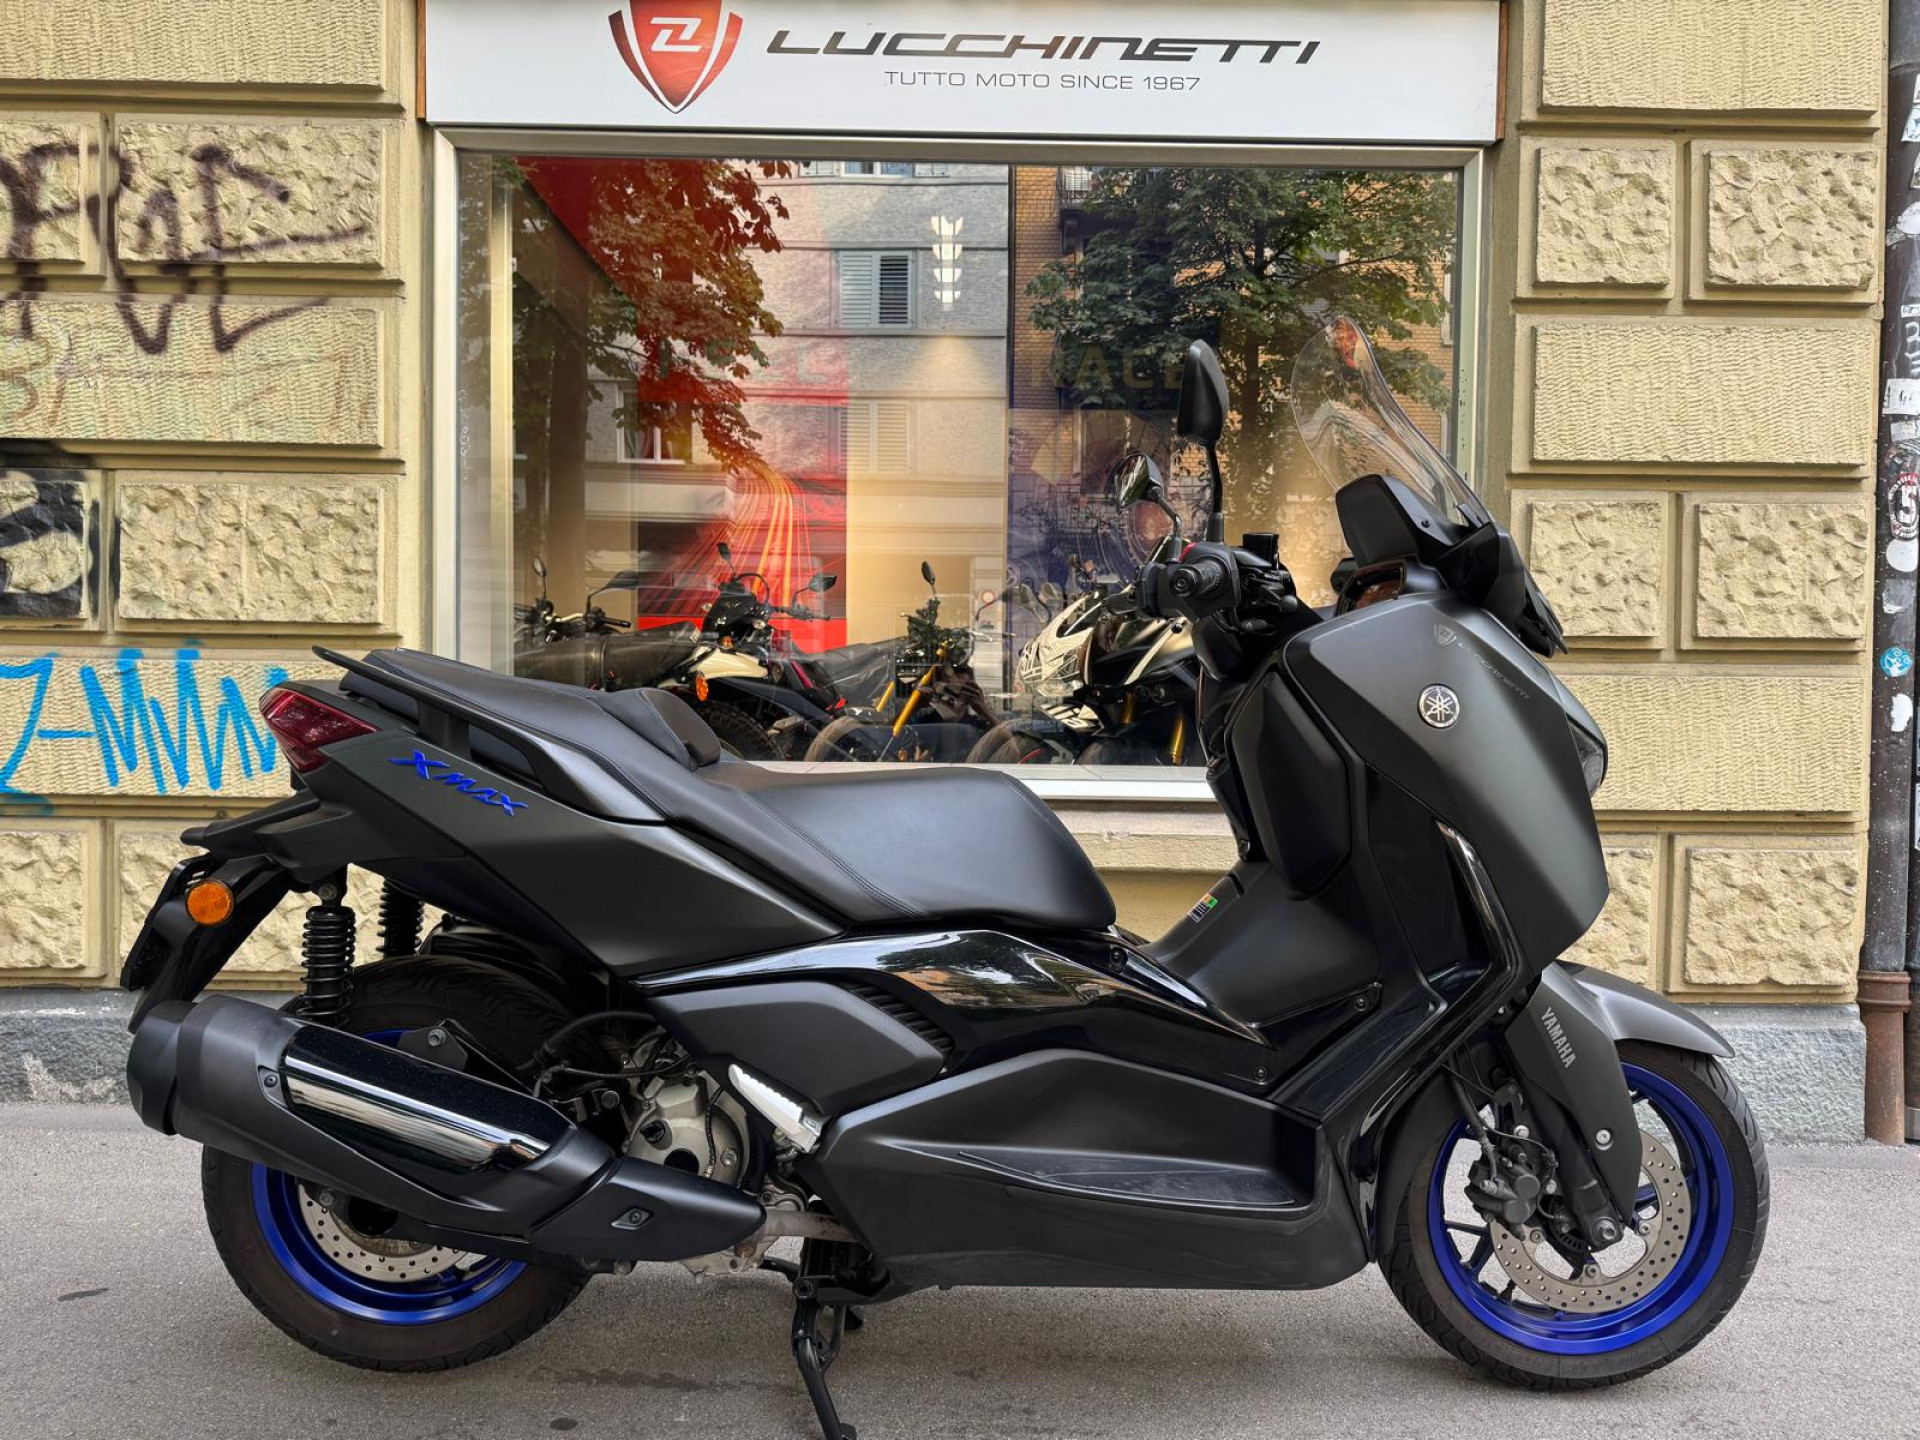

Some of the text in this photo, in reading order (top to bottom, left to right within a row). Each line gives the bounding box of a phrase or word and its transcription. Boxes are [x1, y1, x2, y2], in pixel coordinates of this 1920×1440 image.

[766, 30, 1320, 64] LUCCHINETTI
[884, 71, 1201, 91] TUTTO MOTO SINCE 1967
[386, 749, 529, 817] XMAX
[1541, 1006, 1577, 1068] YAMAHA
